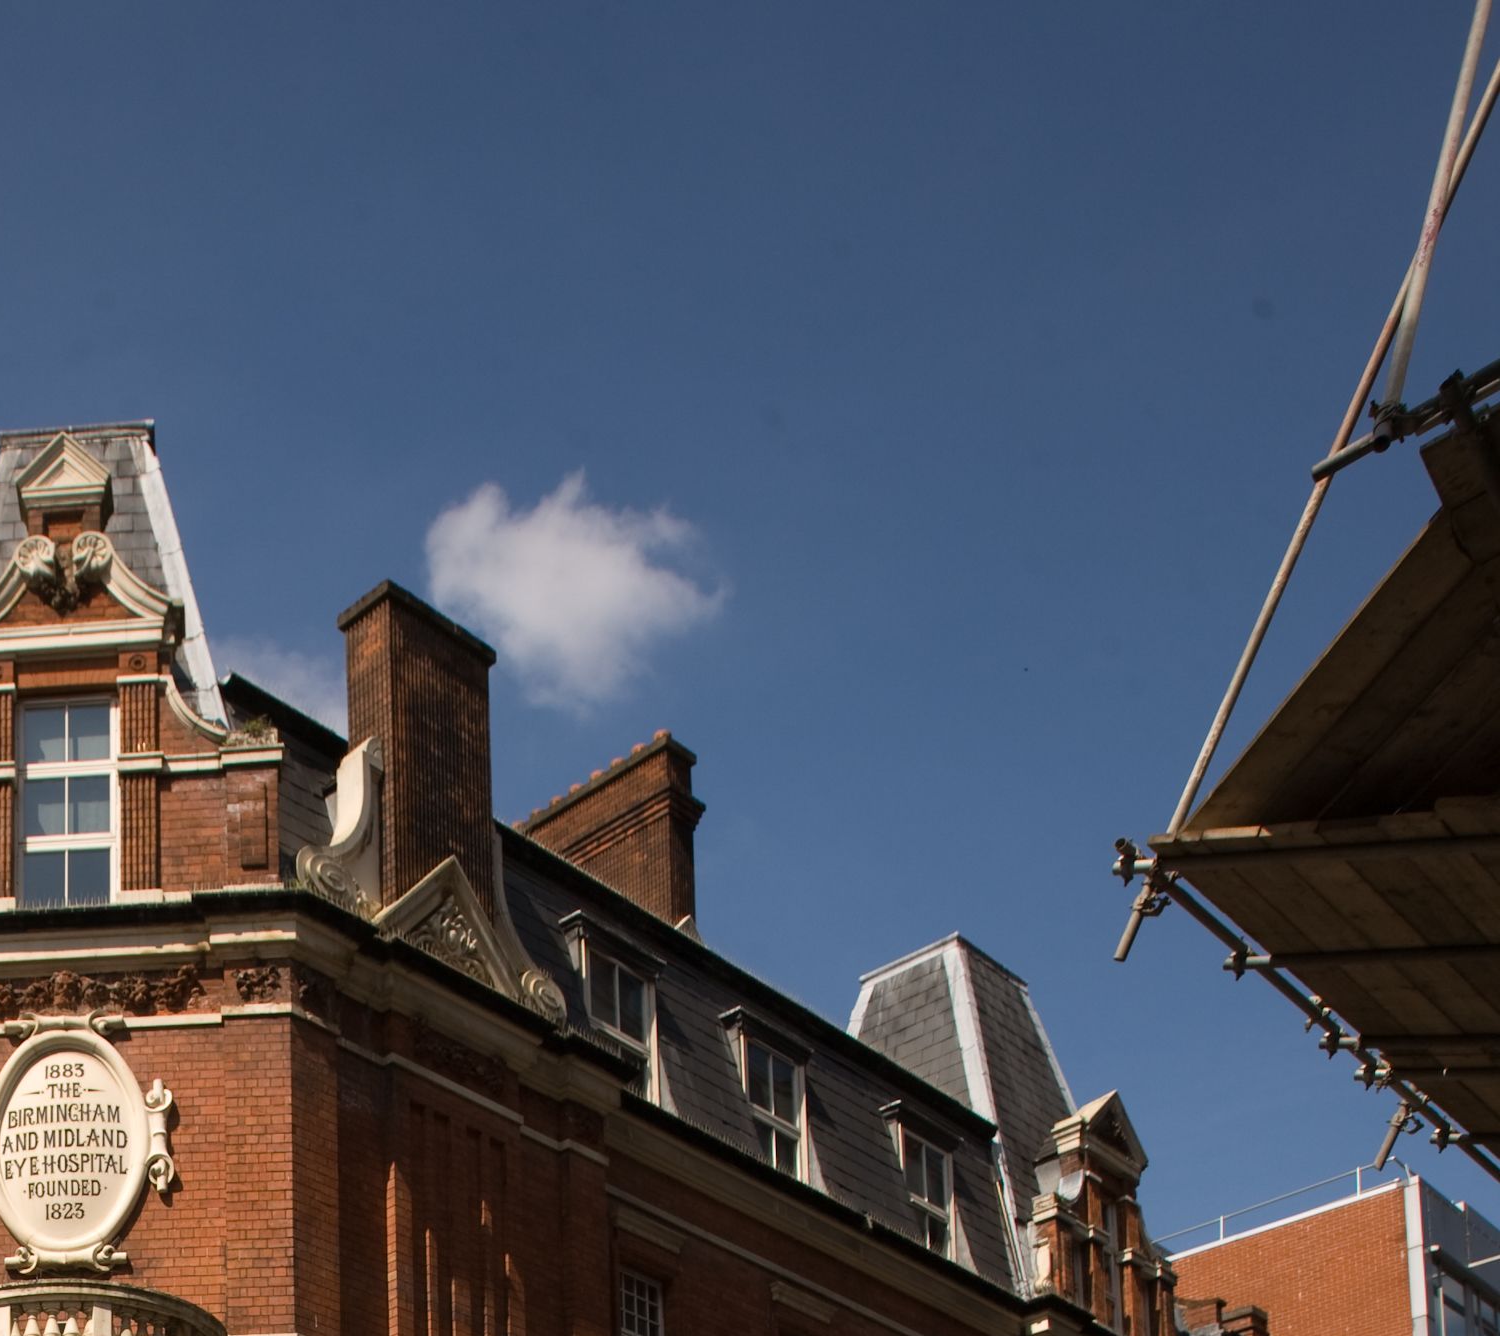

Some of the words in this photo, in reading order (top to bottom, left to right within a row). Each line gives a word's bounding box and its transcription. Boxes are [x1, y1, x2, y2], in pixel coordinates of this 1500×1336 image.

[45, 1063, 85, 1079] 1883
[47, 1082, 81, 1099] THE
[7, 1103, 121, 1129] BIRMINGHAM
[2, 1131, 39, 1155] AND
[43, 1128, 128, 1149] MIDLAND
[5, 1156, 40, 1180] EYE
[42, 1153, 129, 1175] HOSPITAL
[28, 1179, 101, 1199] FOUNDED
[45, 1202, 85, 1220] 1823
